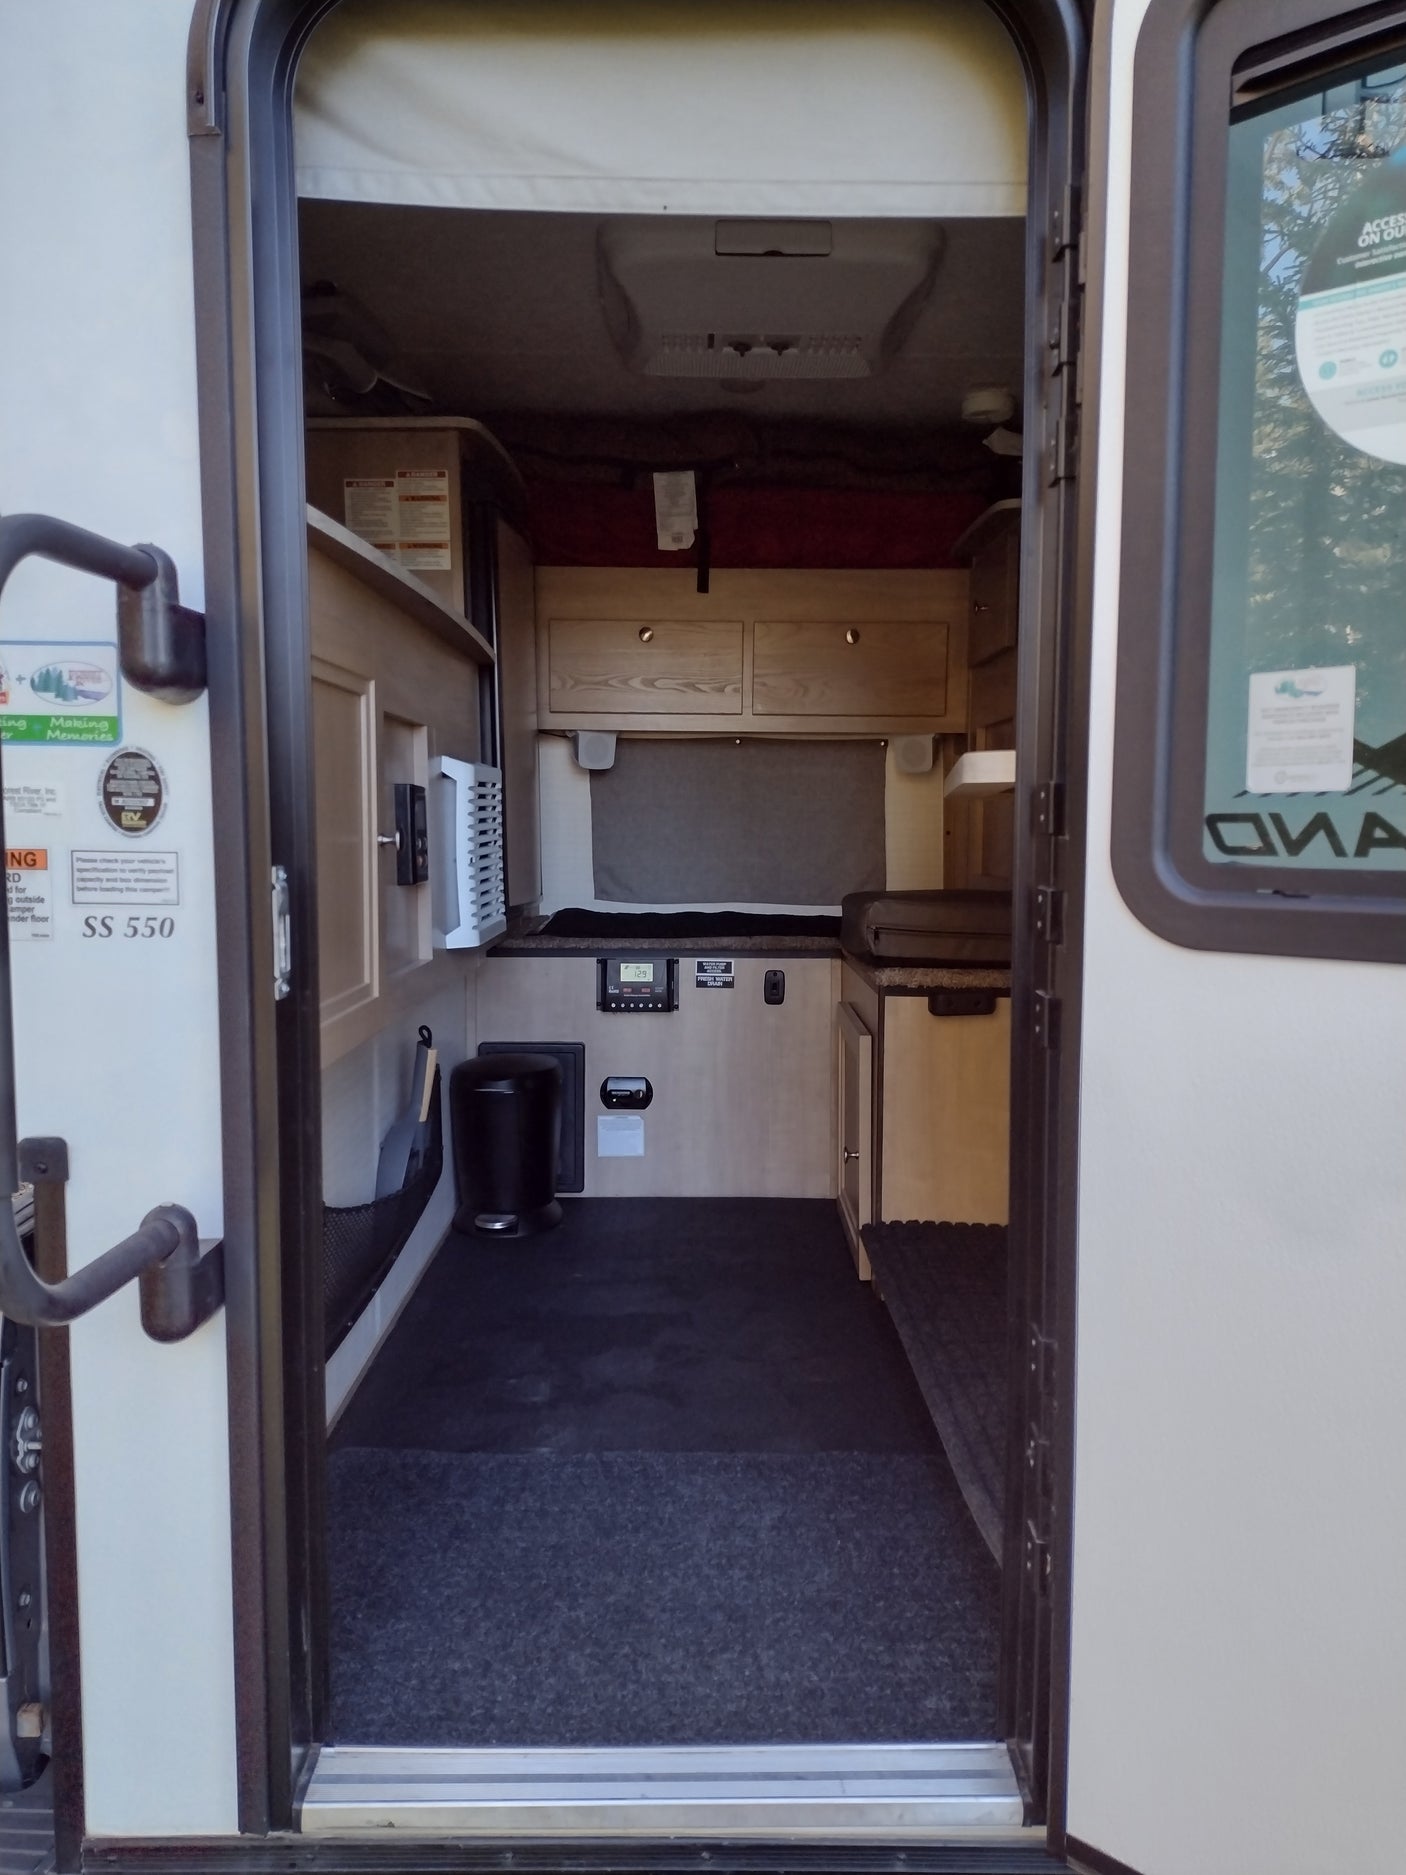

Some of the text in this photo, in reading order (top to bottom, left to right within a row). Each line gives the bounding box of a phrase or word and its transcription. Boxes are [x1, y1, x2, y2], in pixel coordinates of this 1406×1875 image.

[1362, 212, 1406, 237] ACCES
[1357, 231, 1381, 248] ON
[0, 716, 109, 732] ing Making
[46, 729, 114, 741] Memories
[15, 886, 27, 894] for
[15, 895, 46, 904] outside
[8, 906, 36, 914] amper
[31, 914, 50, 923] floor
[82, 915, 175, 938] SS 550
